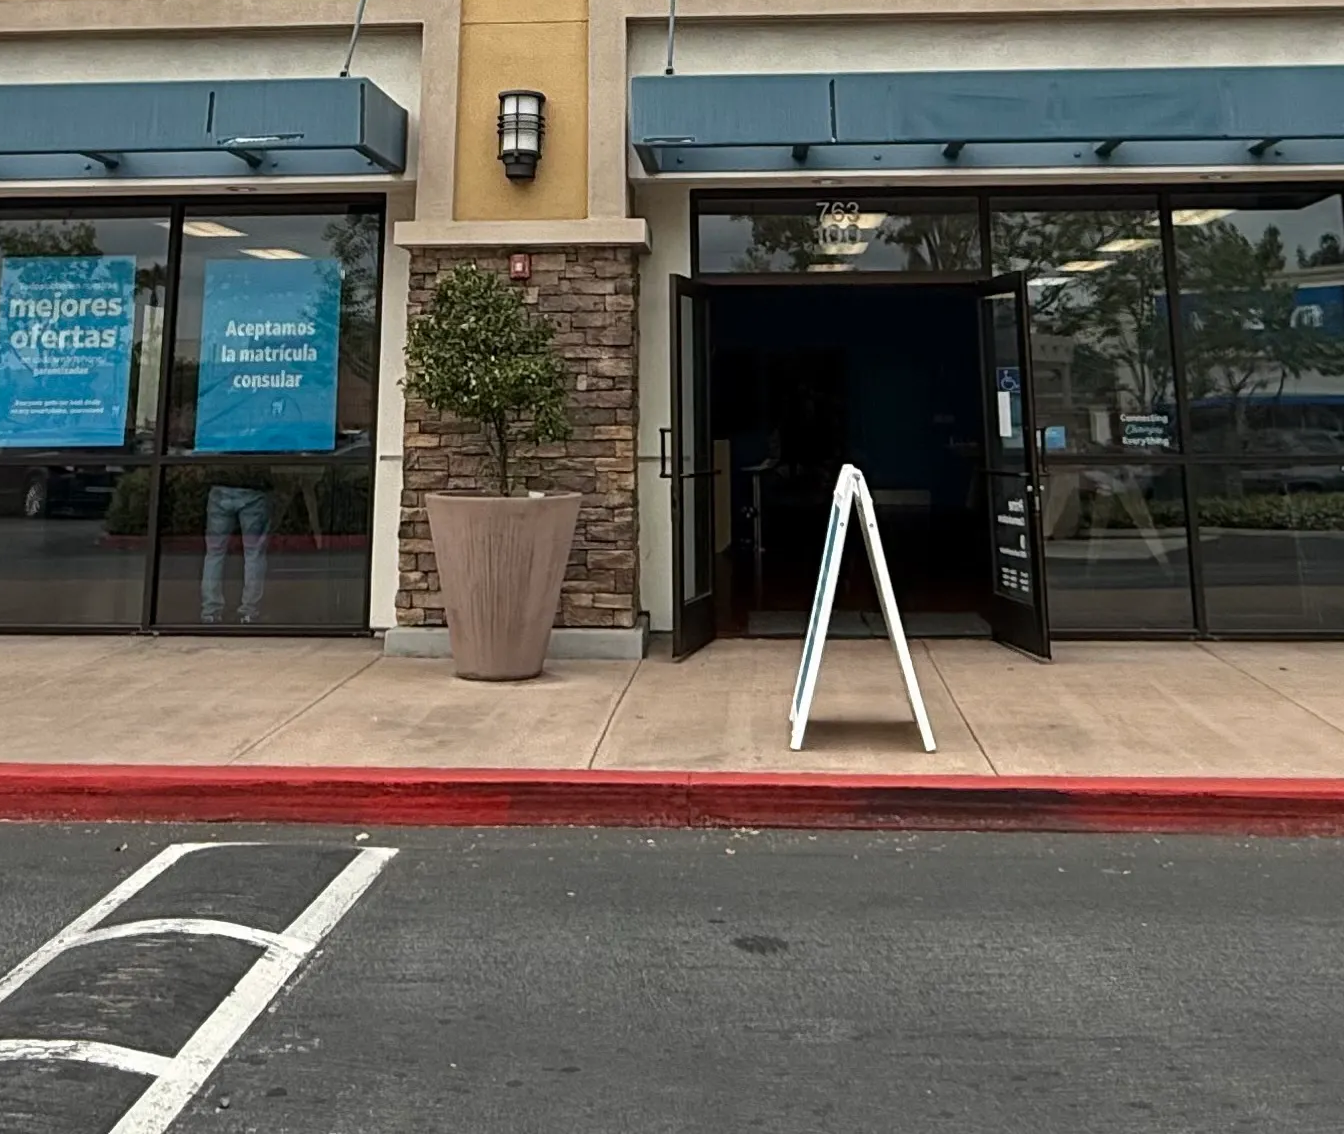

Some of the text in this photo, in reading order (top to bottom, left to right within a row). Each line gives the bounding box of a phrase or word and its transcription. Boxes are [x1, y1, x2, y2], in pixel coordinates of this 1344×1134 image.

[816, 201, 861, 223] 763
[814, 223, 862, 246] 100
[9, 292, 122, 323] mejores
[10, 323, 117, 350] ofertas
[225, 320, 316, 341] Aceptamos
[221, 343, 318, 363] la matrícula
[233, 369, 304, 388] consular
[1120, 414, 1168, 424] Connecting
[1122, 436, 1170, 447] Everything
